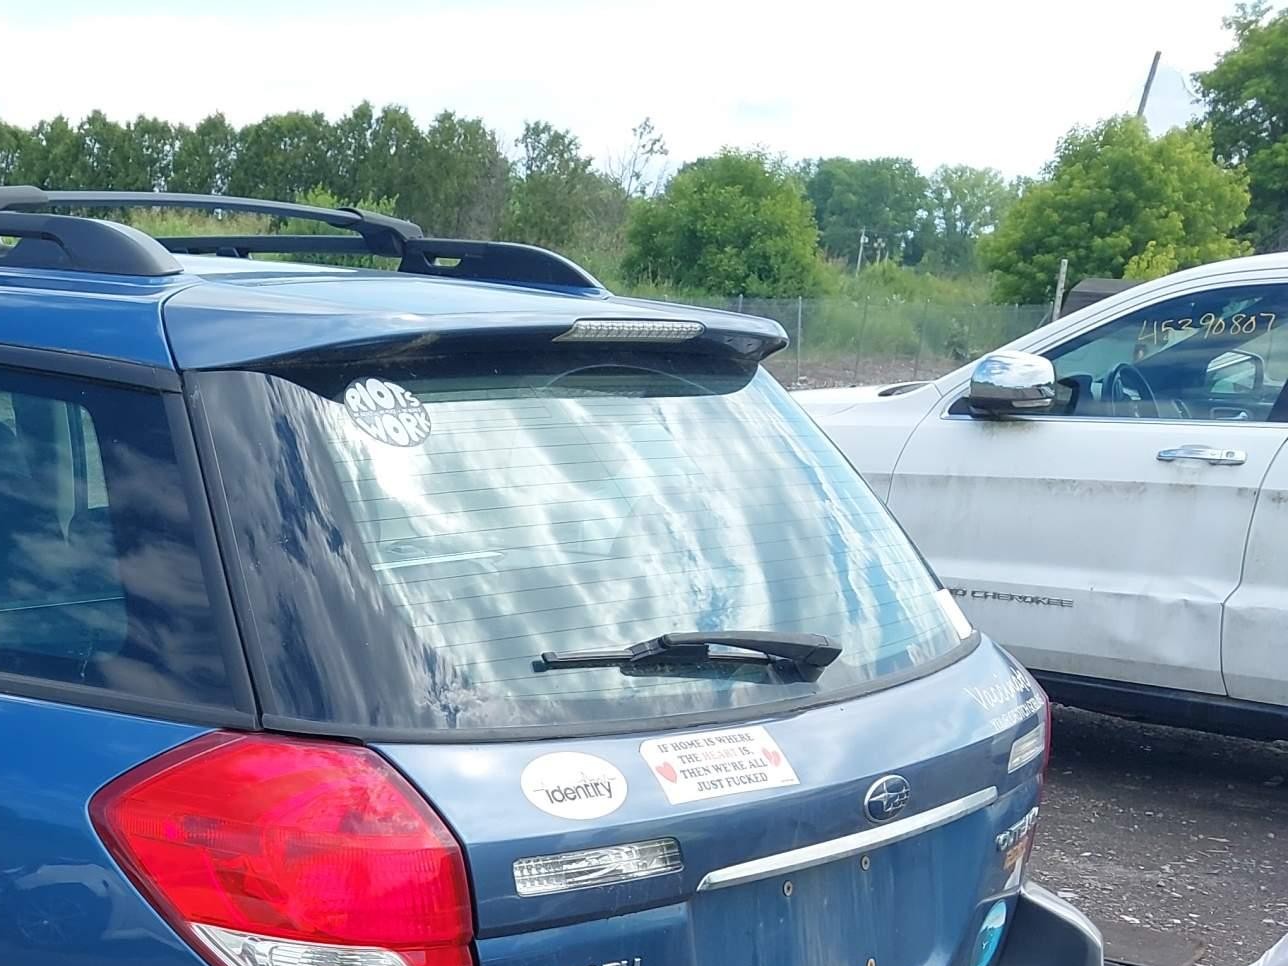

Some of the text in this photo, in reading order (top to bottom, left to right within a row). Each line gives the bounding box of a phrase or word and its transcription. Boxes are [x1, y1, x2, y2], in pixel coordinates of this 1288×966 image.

[345, 378, 421, 412] RIOTS
[355, 411, 431, 446] WORK
[971, 590, 1073, 608] CHEROKEE
[657, 732, 754, 753] IF HOME IS WHERE
[677, 753, 703, 765] THE
[702, 748, 738, 761] HEART
[680, 757, 769, 780] THEN WE'RE ALL
[697, 779, 725, 792] JUST
[726, 772, 768, 787] FUCKED
